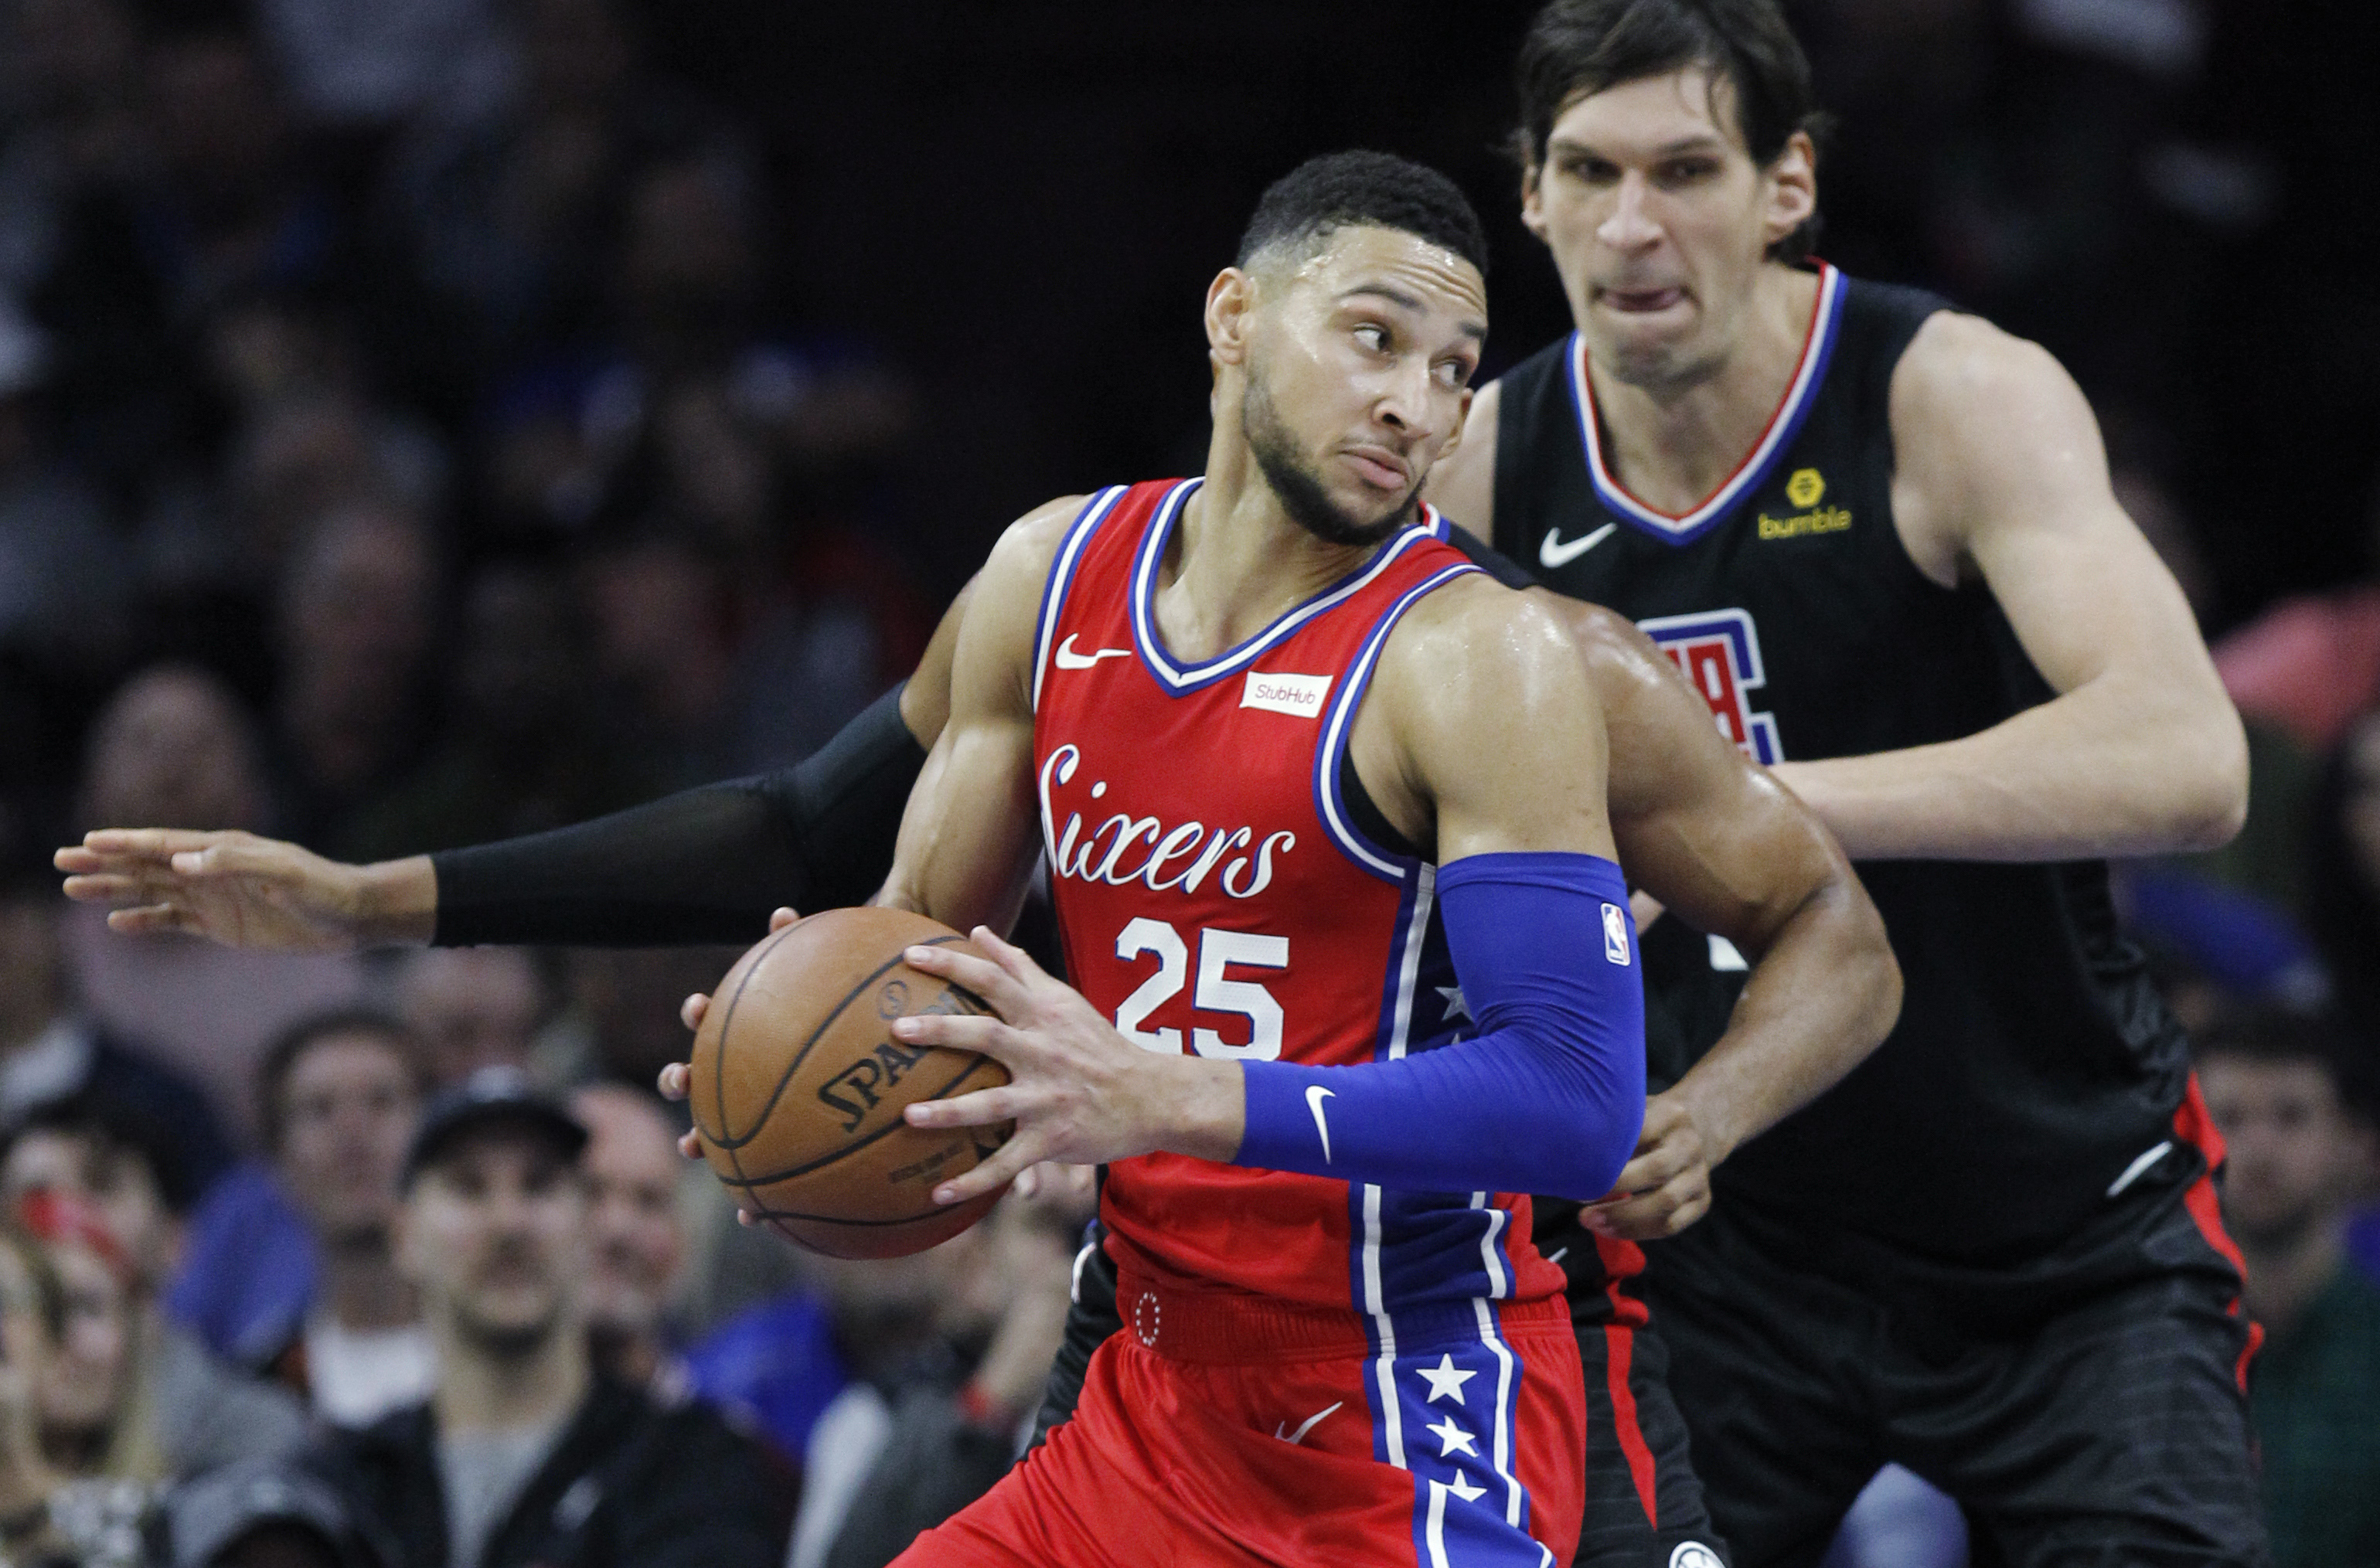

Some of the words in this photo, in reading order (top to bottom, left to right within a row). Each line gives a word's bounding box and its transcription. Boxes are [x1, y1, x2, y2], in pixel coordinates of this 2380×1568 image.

[1759, 505, 1852, 539] bumble
[1255, 683, 1316, 705] StubHub
[1115, 917, 1289, 1062] 25
